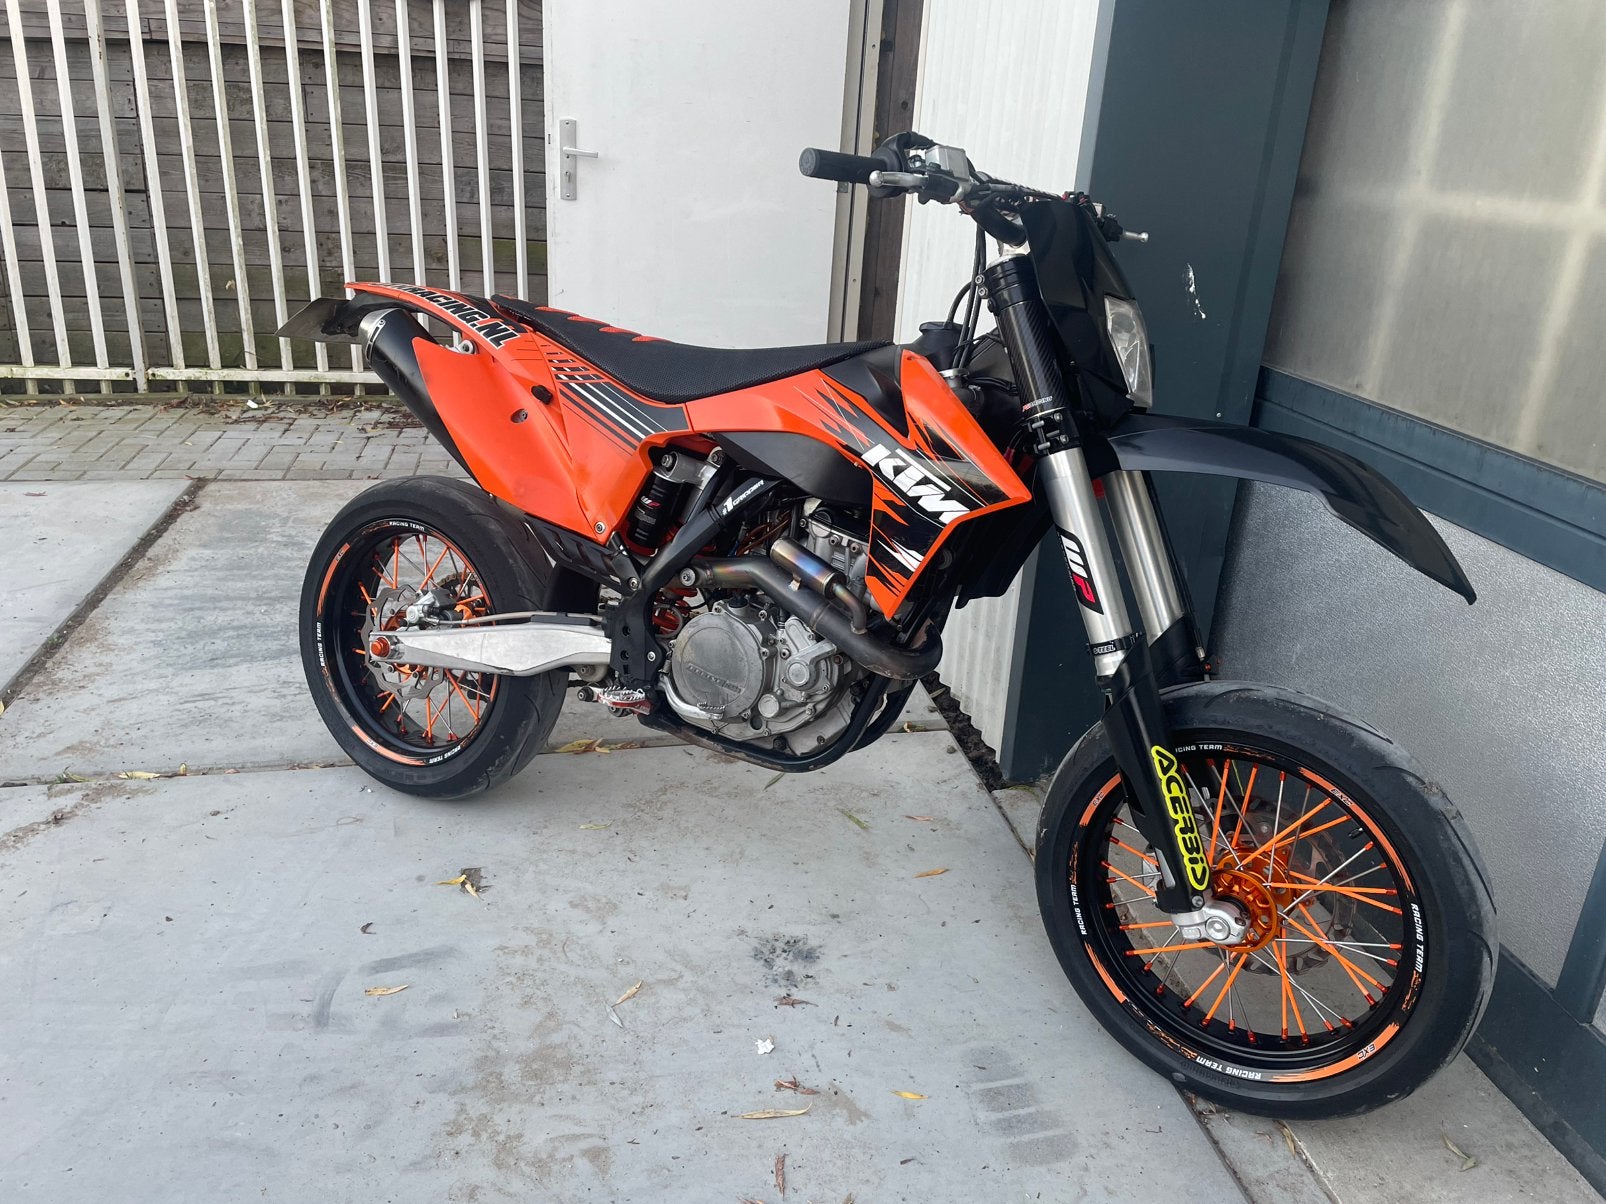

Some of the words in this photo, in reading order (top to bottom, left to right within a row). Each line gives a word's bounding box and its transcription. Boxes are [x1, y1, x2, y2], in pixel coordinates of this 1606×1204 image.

[861, 444, 970, 526] KTM
[1060, 534, 1096, 603] WP
[317, 642, 326, 667] RACING
[1070, 884, 1079, 906] TEAM
[1073, 906, 1088, 936] RACING
[1411, 902, 1425, 942] RACING
[1414, 943, 1425, 973] TEAM
[1195, 1055, 1224, 1072] TEAM
[1357, 1043, 1377, 1060] EXC
[1225, 1066, 1262, 1080] RACING
